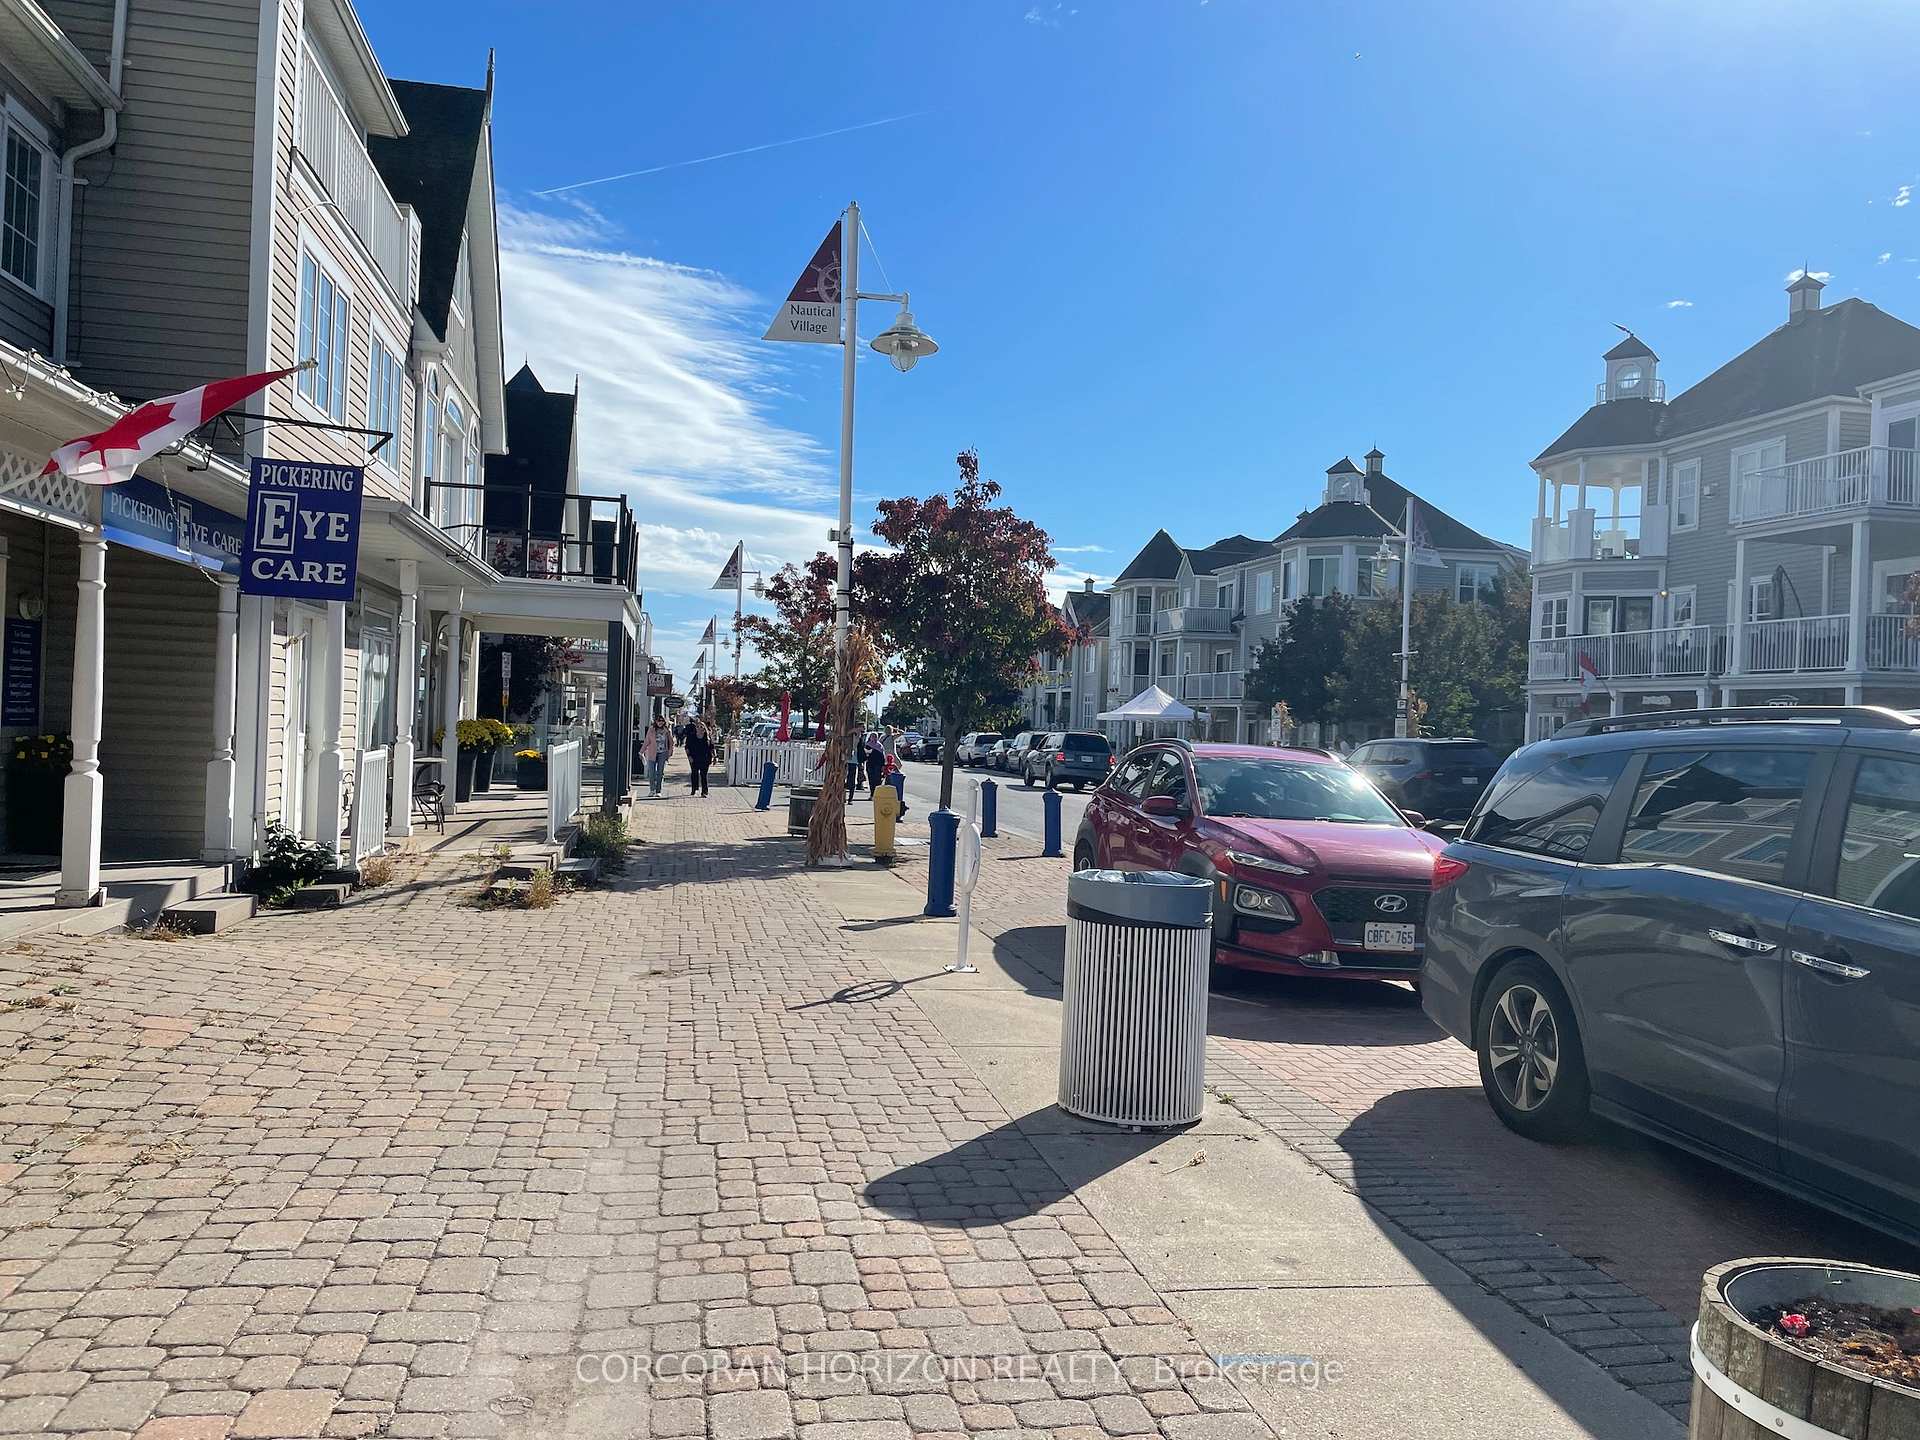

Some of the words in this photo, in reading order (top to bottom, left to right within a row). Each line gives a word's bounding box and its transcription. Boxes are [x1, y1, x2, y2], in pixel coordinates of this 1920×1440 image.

[790, 304, 835, 318] Nautical
[790, 319, 828, 334] Village
[259, 463, 354, 492] PICKERING
[110, 491, 174, 533] PICKERING
[212, 531, 242, 556] CARE
[259, 497, 350, 548] EYE
[251, 557, 347, 585] CARE
[1367, 929, 1391, 943] CBFC
[1396, 930, 1413, 945] 765
